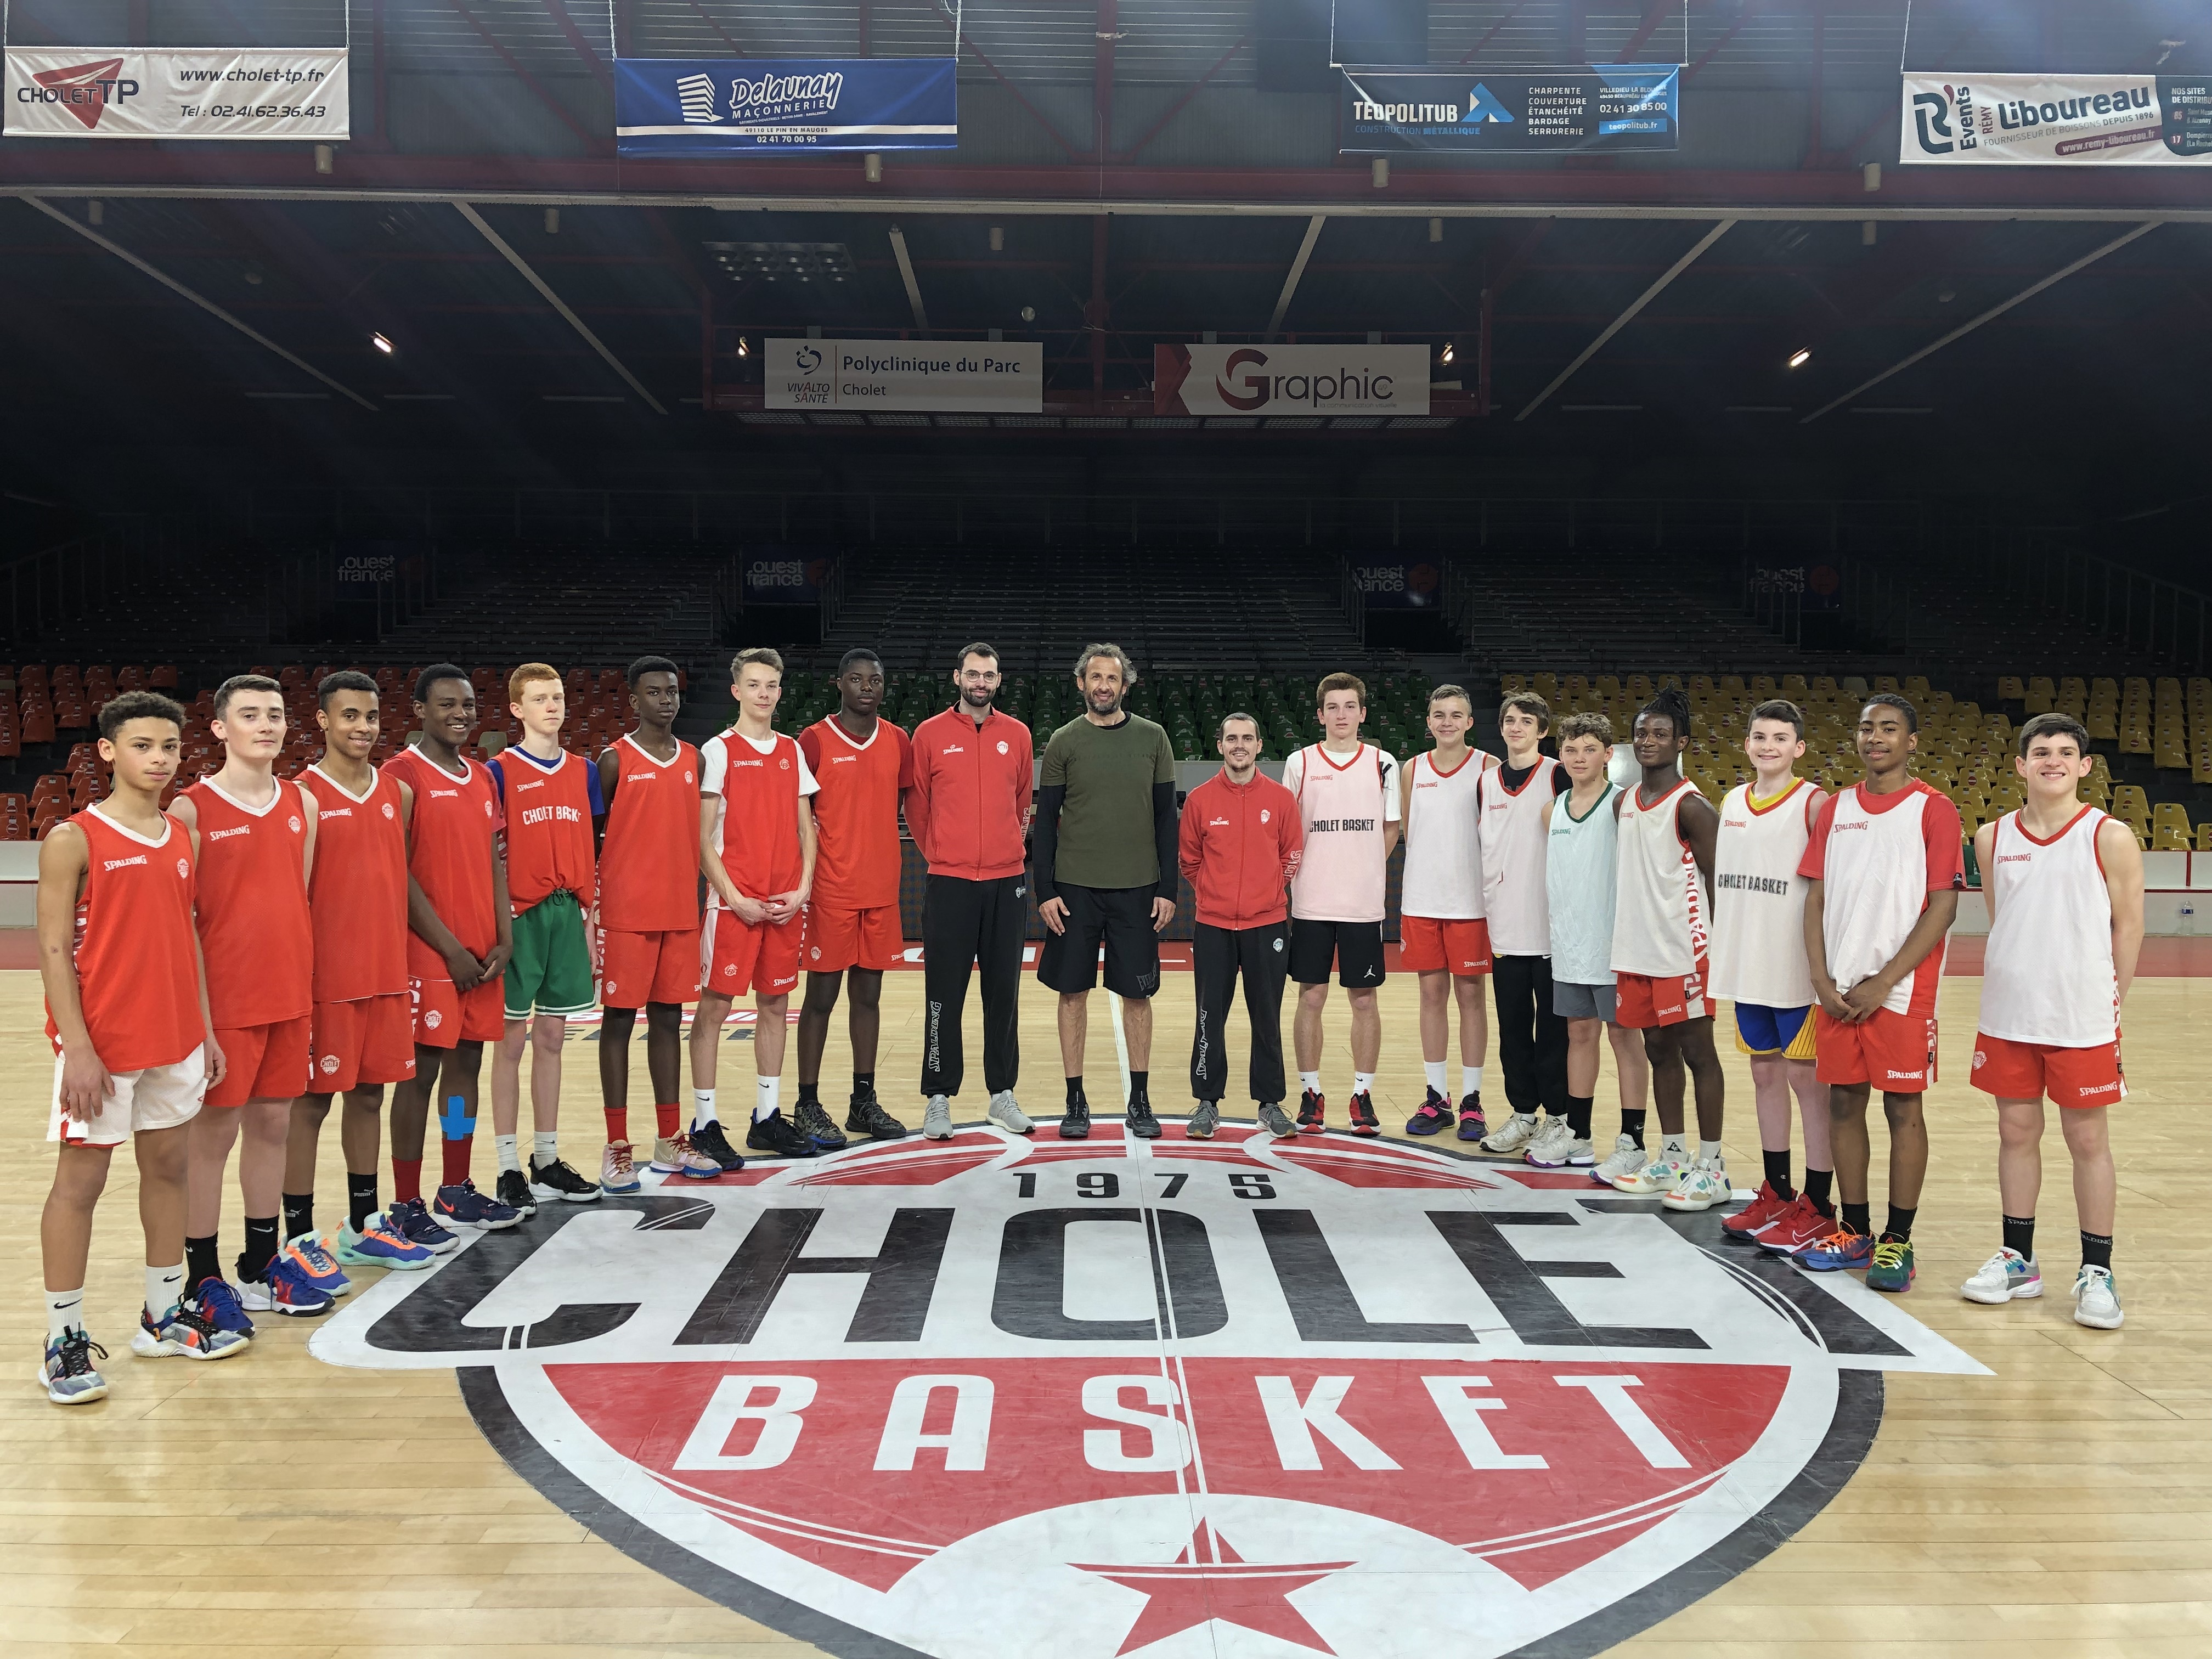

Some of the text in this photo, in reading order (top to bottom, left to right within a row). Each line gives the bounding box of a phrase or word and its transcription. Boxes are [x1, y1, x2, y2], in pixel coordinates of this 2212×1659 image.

[180, 68, 324, 85] www.cholet-tp.fr
[17, 78, 139, 104] CHOLET TP
[729, 72, 843, 110] Delaunay
[180, 105, 199, 117] Tel
[211, 105, 326, 118] 02.41.62.36.43
[732, 99, 825, 119] MAÇONNERIE
[1353, 101, 1458, 122] TEOPOLITUB
[1528, 106, 1583, 115] ÉTANCHÉITÉ
[1599, 102, 1667, 113] 02 41 30 85 00
[1998, 86, 2151, 130] Liboureau
[1956, 86, 1977, 150] Events
[1355, 125, 1421, 134] CONSTRUCTION
[1609, 121, 1657, 130] teopolitub.fr
[1984, 111, 2154, 146] FOURNISSEUR DE BOISSONS DEPUIS 1896
[2172, 135, 2181, 143] 17
[843, 355, 1020, 375] Polyclinique du Parc
[1216, 348, 1393, 411] Graphic
[787, 382, 830, 393] VIVALTO
[843, 383, 887, 396] Cholet
[345, 554, 395, 569] ouest
[753, 558, 803, 573] ouest
[746, 569, 804, 586] france
[1359, 579, 1404, 592] ance
[733, 759, 764, 768] SPALDING
[831, 755, 857, 764] SPALDING
[627, 771, 656, 782] SPALDING
[517, 779, 544, 792] SPALDING
[430, 789, 459, 798] SPALDING
[319, 808, 352, 820] SPALDING
[1309, 819, 1375, 833] CHOLET BASKET
[1724, 820, 1747, 828] SPALDING
[1833, 821, 1869, 833] SPALDING
[210, 824, 250, 842] SPALDING
[104, 854, 148, 871] SPALDING
[1997, 853, 2032, 864] SPALDING
[1748, 874, 1789, 896] BASKET
[1464, 959, 1488, 968] SPALDING
[928, 1000, 942, 1073] SPALDING
[320, 1059, 341, 1068] CHOLET
[1887, 1069, 1923, 1079] SPALDING
[2079, 1081, 2118, 1097] SPALDING
[673, 1373, 1694, 1474] BASKET
